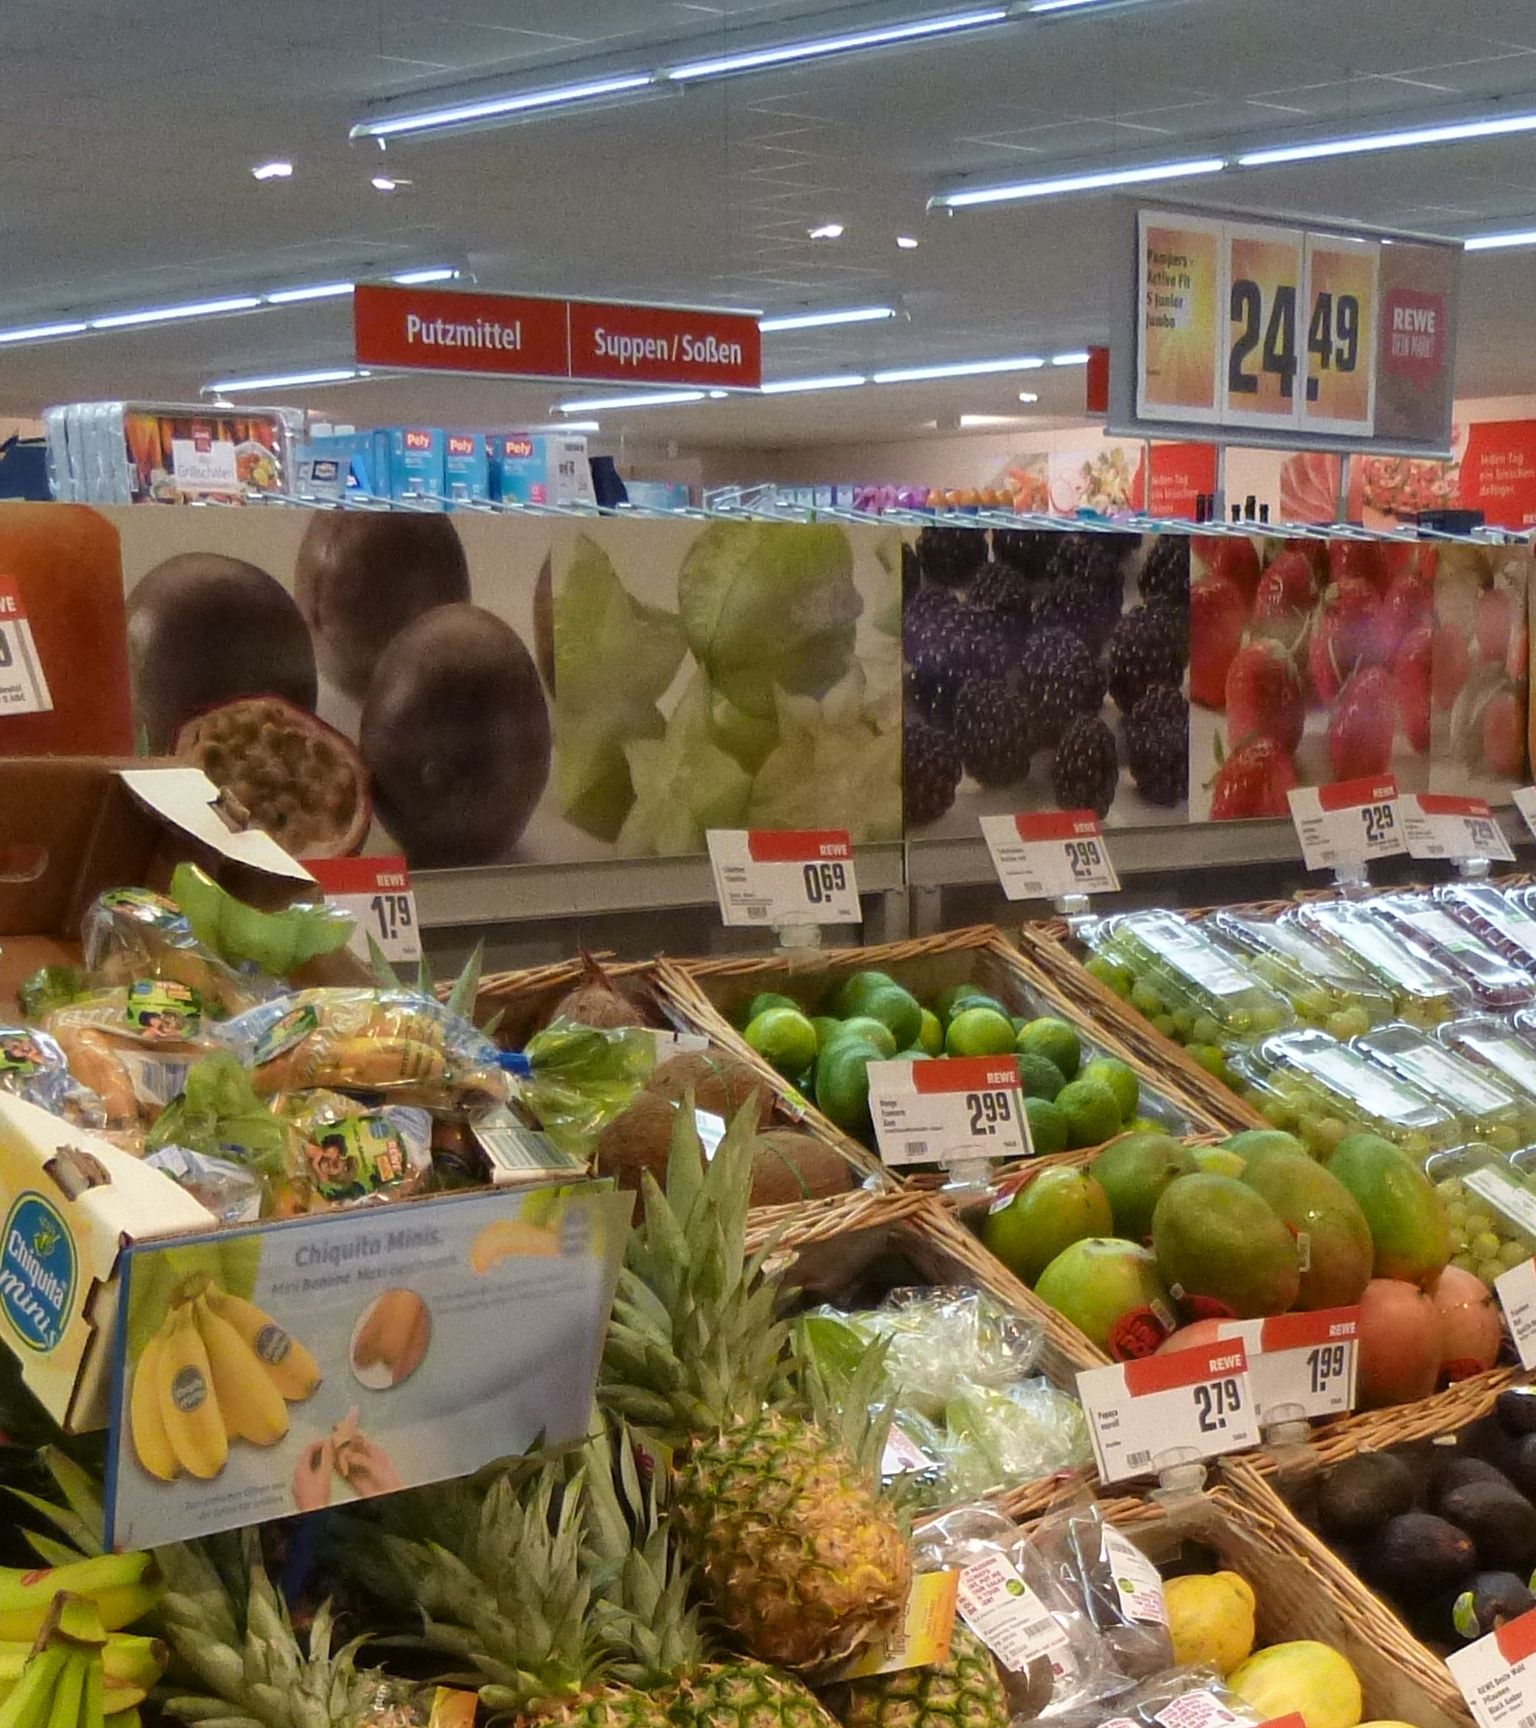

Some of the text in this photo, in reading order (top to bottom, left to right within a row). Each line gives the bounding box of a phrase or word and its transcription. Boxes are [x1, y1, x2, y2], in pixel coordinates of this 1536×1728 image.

[1393, 306, 1436, 332] REWE
[407, 314, 521, 351] Putzmittel
[406, 431, 431, 449] Pely
[449, 437, 473, 455] Pely
[505, 440, 533, 457] Pely
[819, 844, 849, 856] REWE
[376, 873, 406, 887] REWE
[986, 1071, 1017, 1084] REWE
[295, 1237, 382, 1268] Chiquita
[7, 1230, 65, 1311] Chiquita
[1329, 1321, 1356, 1337] REWE
[1208, 1353, 1243, 1373] REWE
